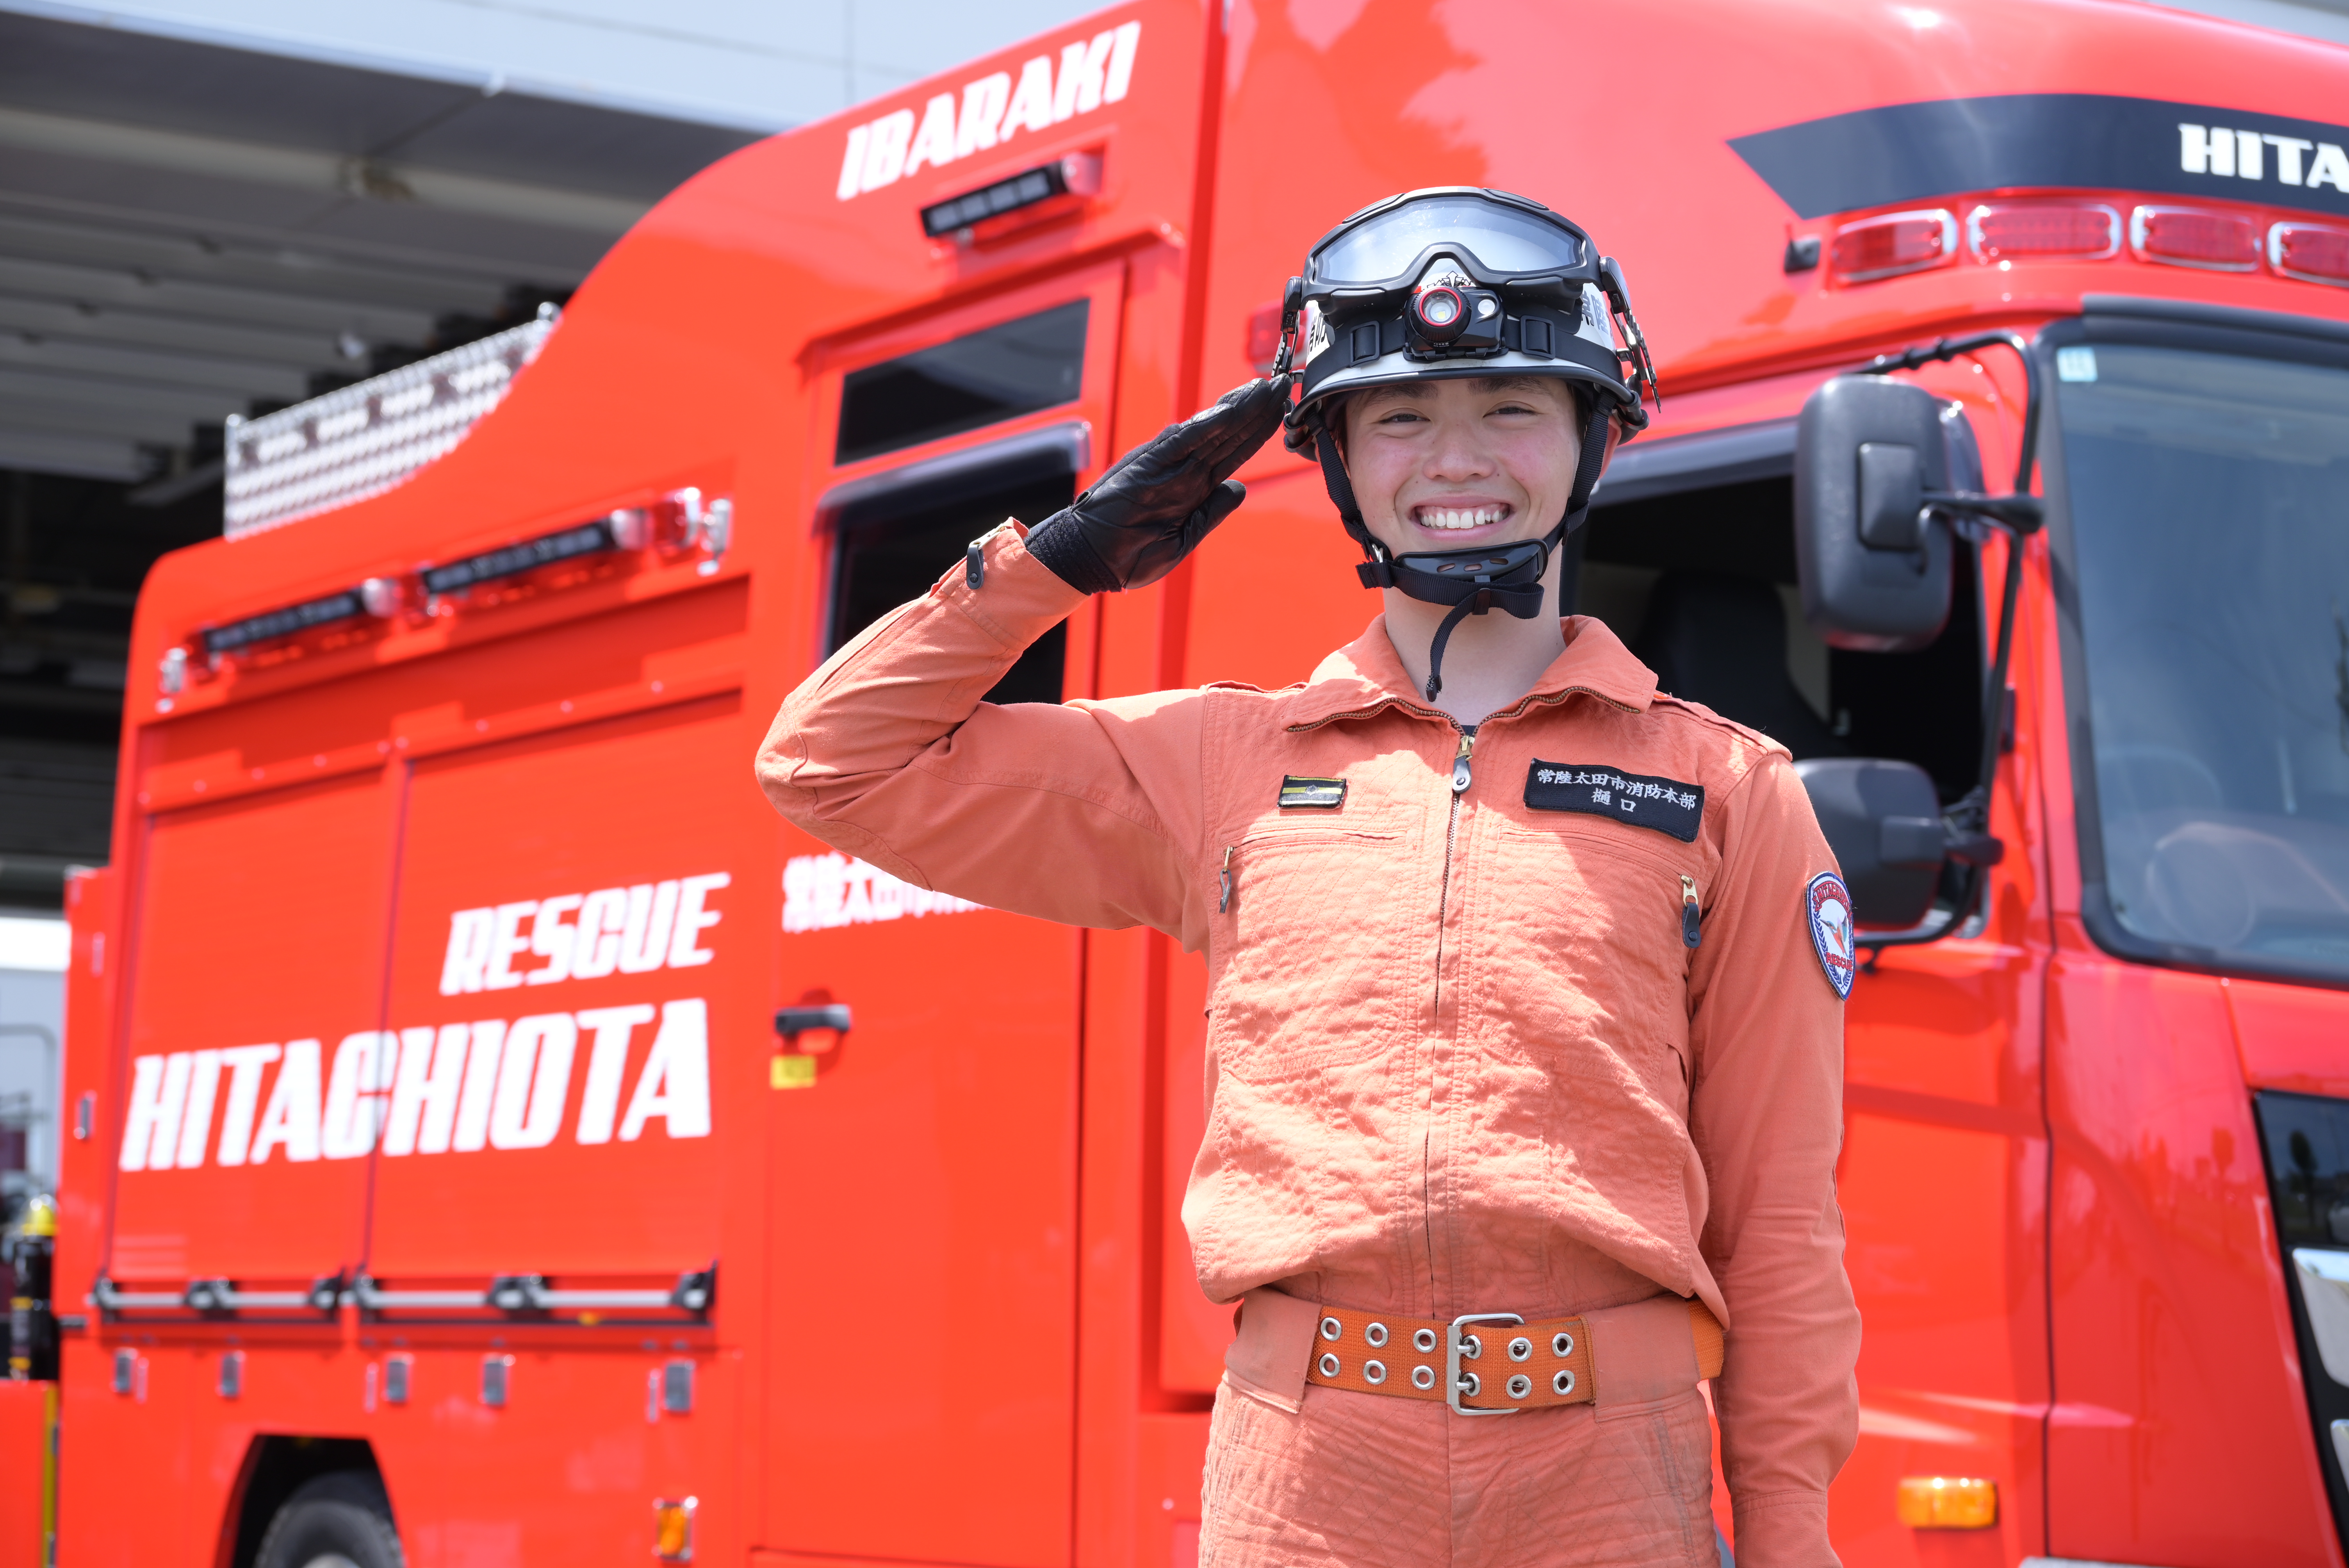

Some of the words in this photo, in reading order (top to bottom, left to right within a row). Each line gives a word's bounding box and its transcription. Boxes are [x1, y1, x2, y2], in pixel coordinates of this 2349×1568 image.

[835, 19, 1142, 202] IBARAKI
[2178, 123, 2349, 193] HITA
[1537, 768, 1697, 811] 常陸太田市消防本部
[1591, 788, 1636, 813] 樋口
[439, 872, 731, 996] RESCUE
[1826, 951, 1853, 972] RESCUE
[119, 998, 711, 1171] HITACHIOTA
